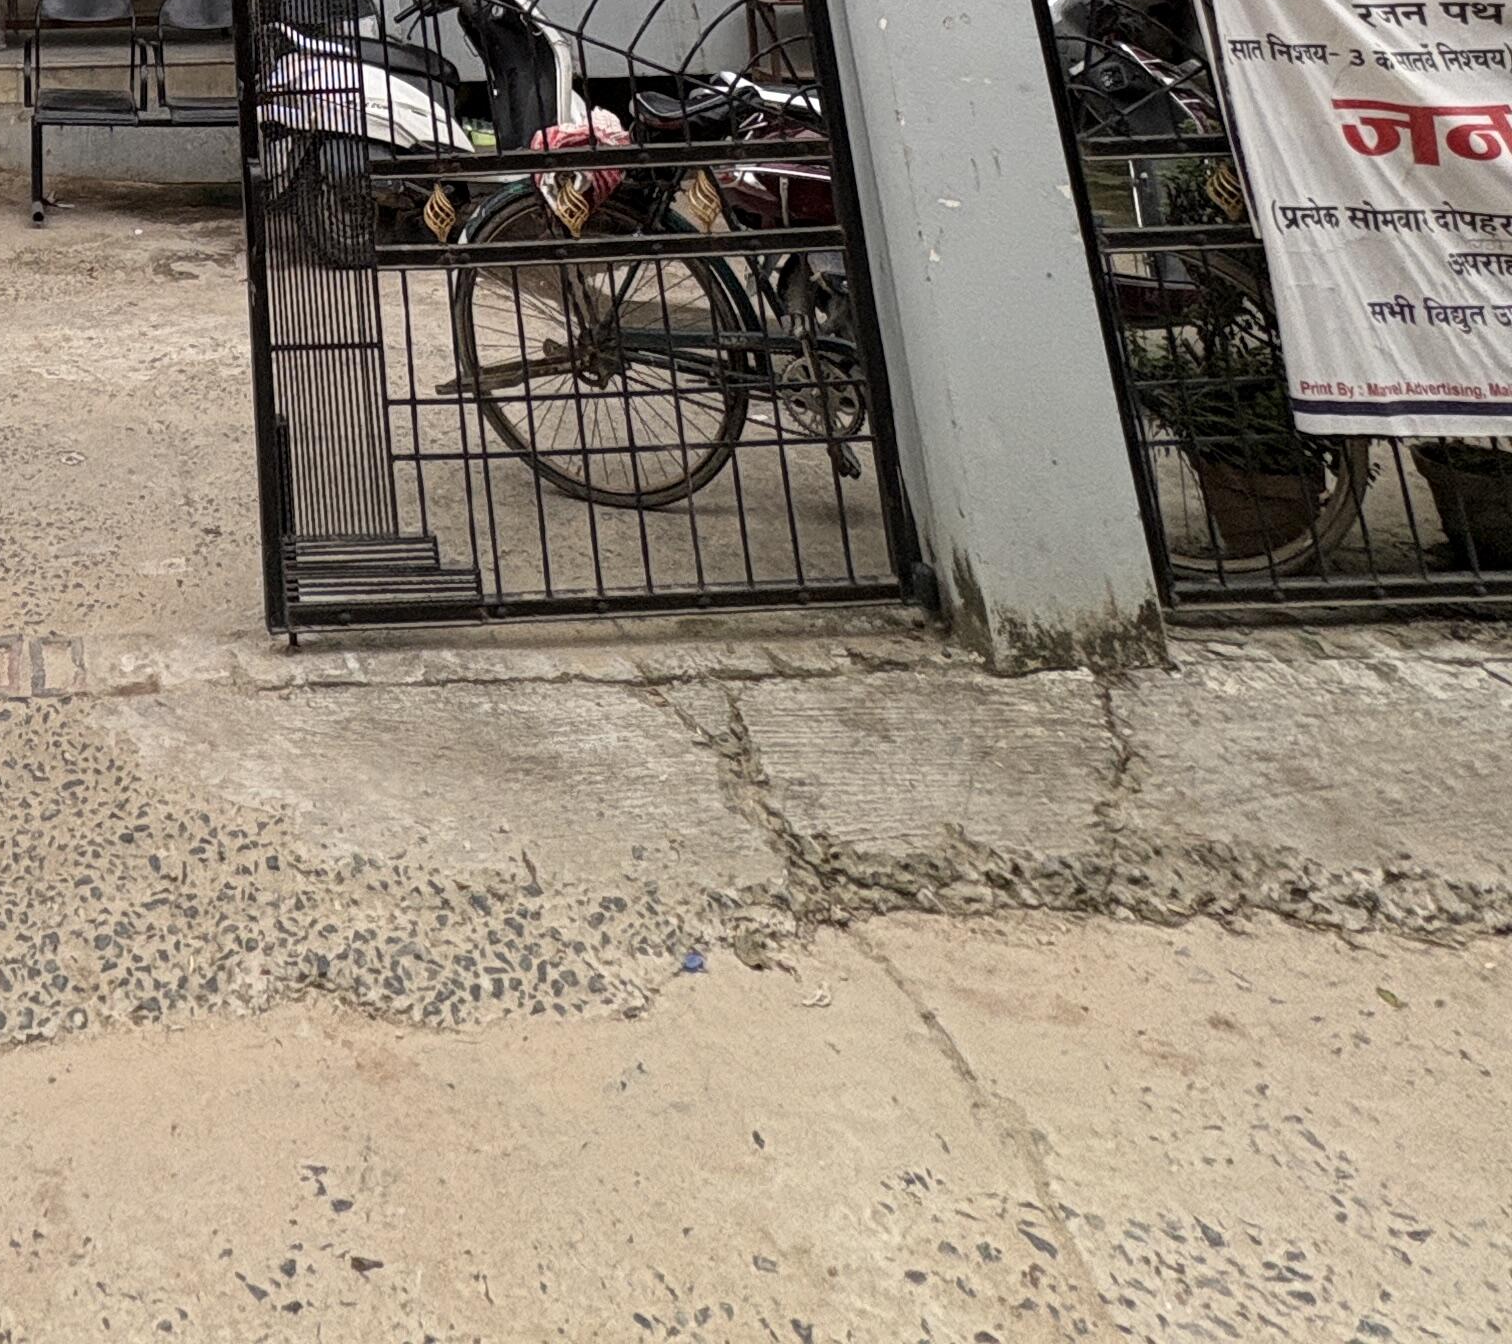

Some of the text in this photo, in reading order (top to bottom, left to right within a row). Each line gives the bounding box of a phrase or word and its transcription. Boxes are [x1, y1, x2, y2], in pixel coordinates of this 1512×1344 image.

[1439, 2, 1506, 26] पथ
[1349, 49, 1366, 67] 3
[1345, 200, 1435, 233] सोमवार
[1431, 200, 1512, 235] दोपहर
[1368, 295, 1415, 325] सभी
[1423, 297, 1488, 334] विद्युत
[1300, 380, 1333, 395] Print
[1338, 381, 1354, 399] By
